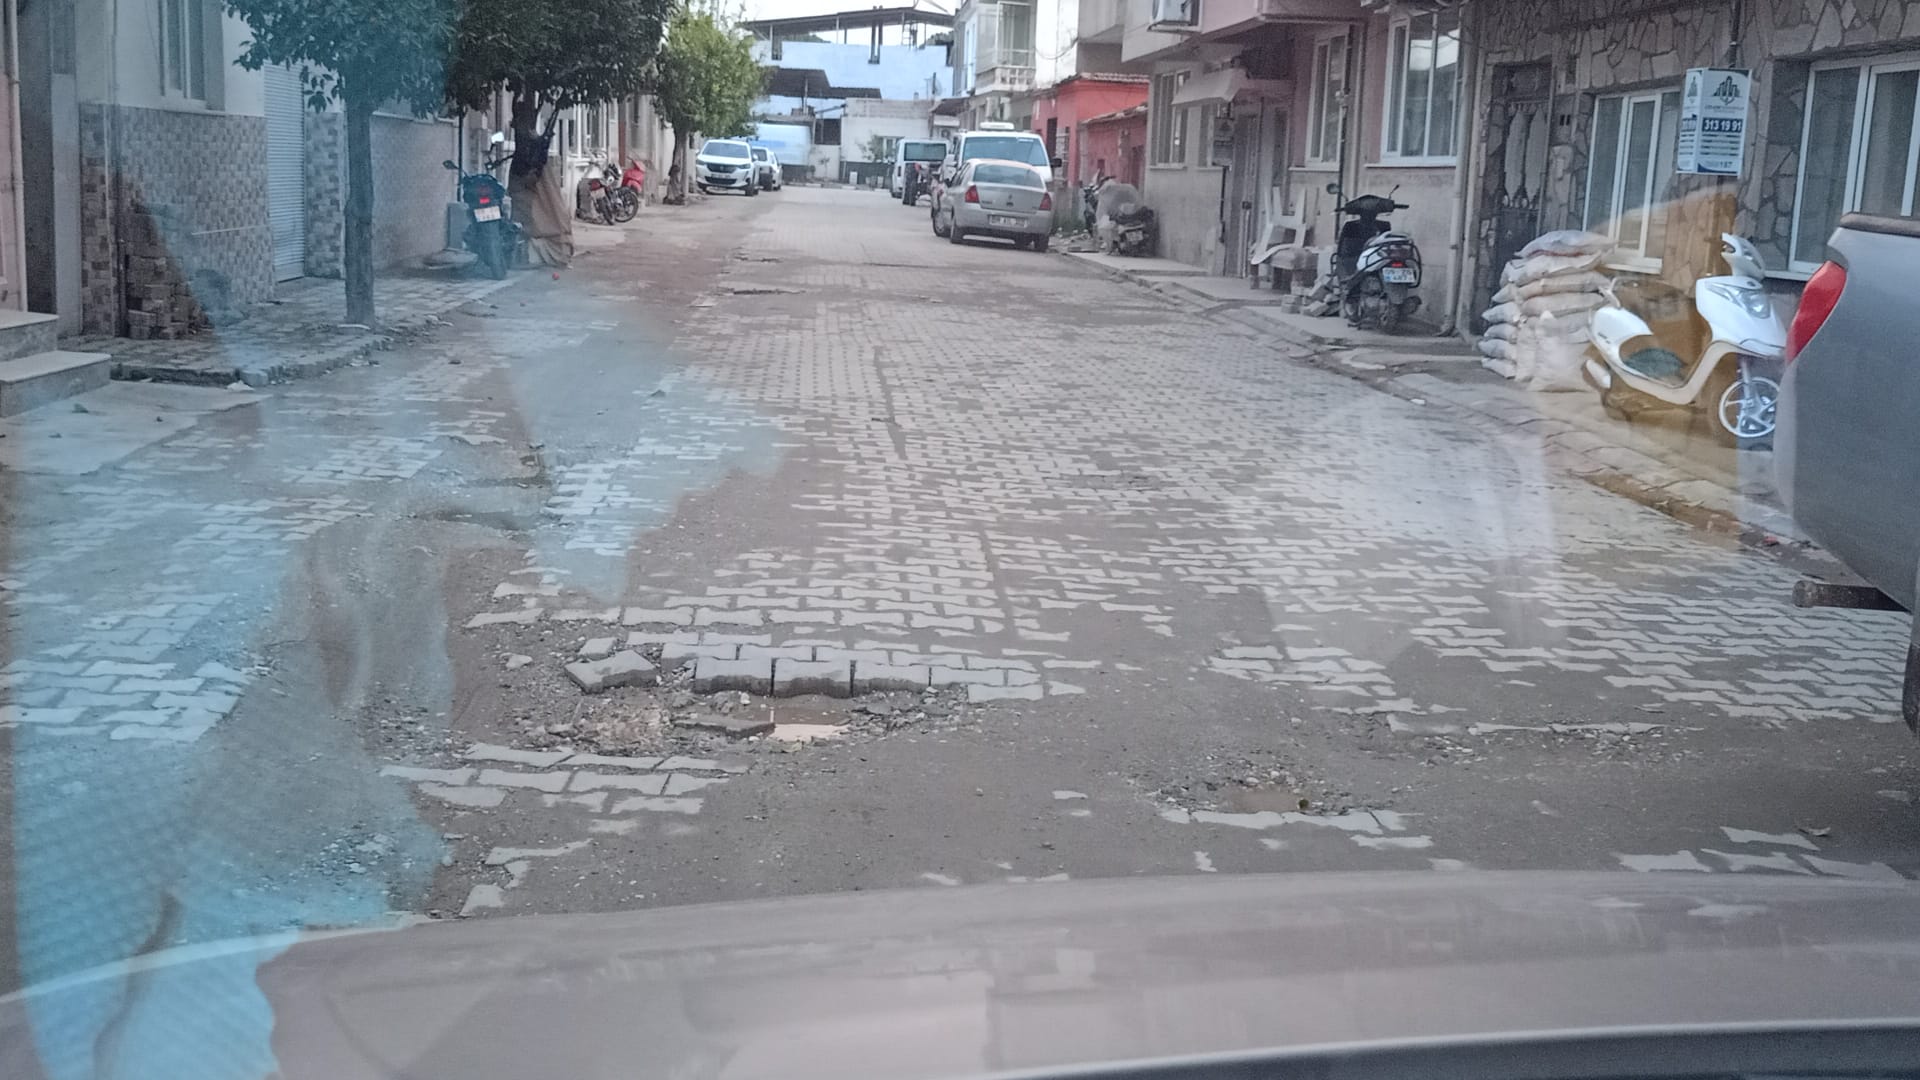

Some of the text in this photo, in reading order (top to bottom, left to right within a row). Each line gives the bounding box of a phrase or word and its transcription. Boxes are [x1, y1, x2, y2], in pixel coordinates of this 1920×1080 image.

[1704, 119, 1719, 131] 313
[1720, 120, 1731, 132] 19
[1731, 120, 1742, 132] 91
